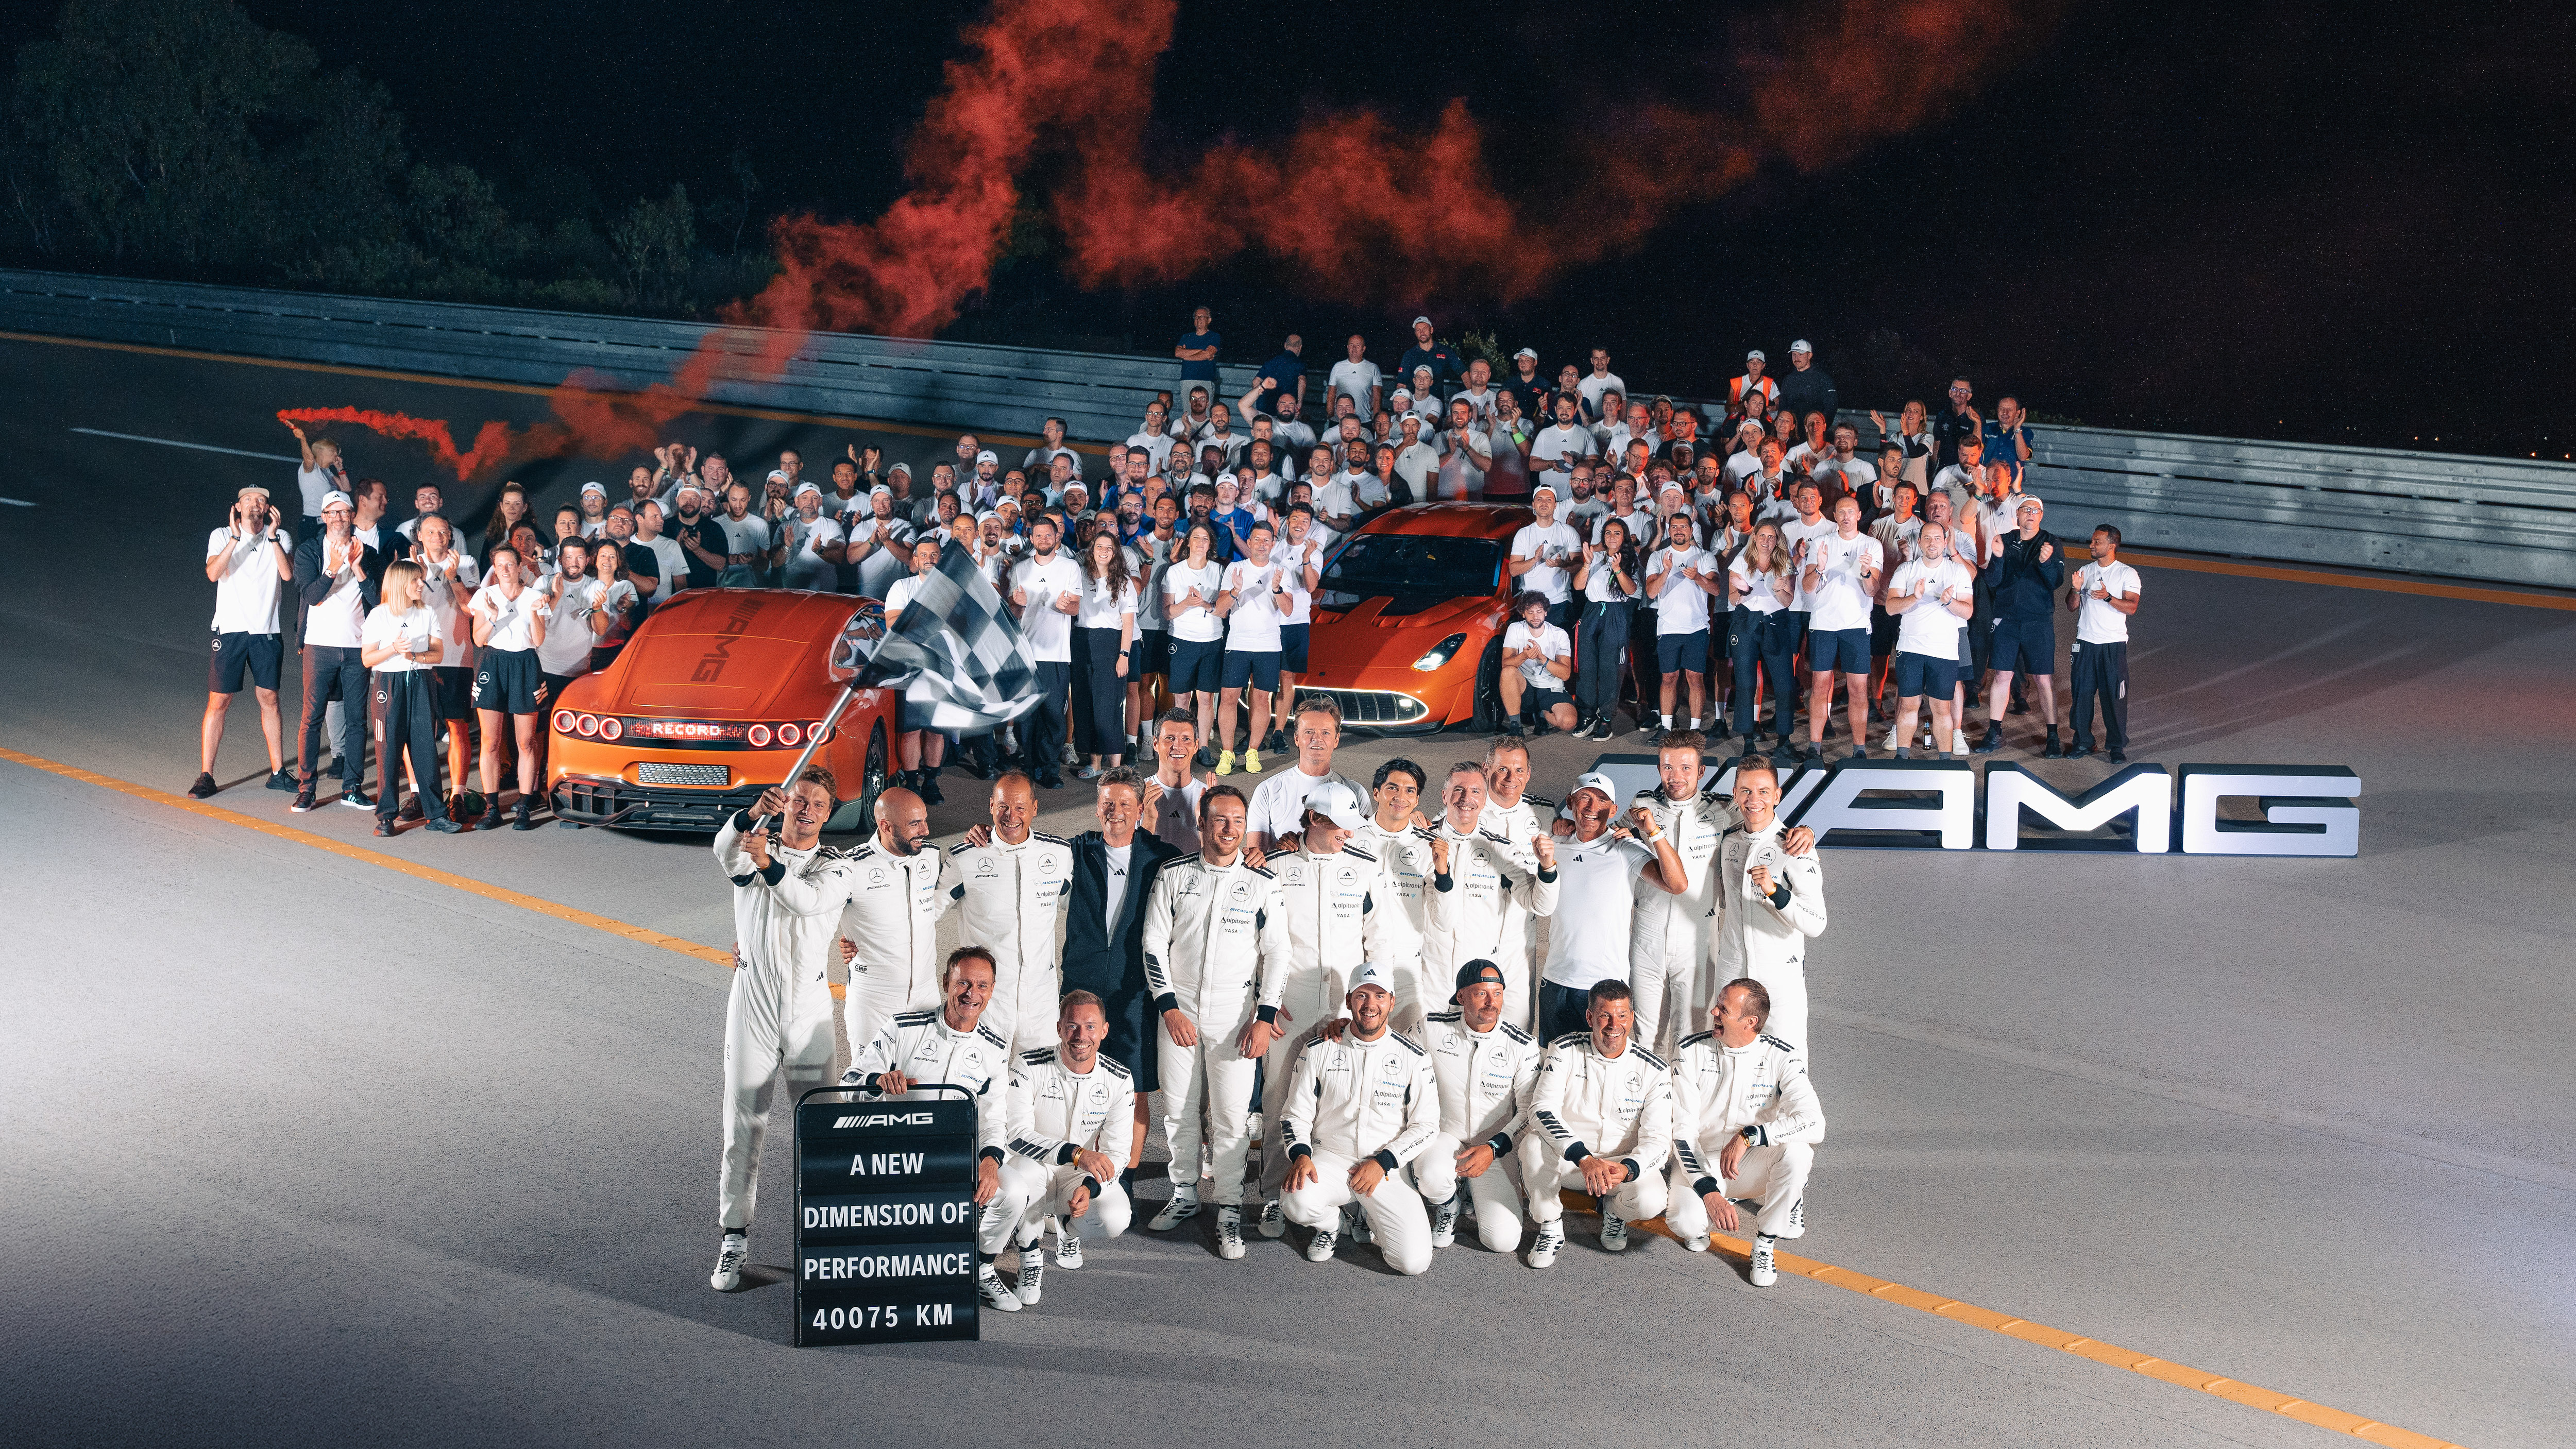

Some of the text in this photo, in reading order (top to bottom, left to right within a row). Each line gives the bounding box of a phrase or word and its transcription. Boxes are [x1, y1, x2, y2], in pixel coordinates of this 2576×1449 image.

[690, 616, 750, 682] AMG
[653, 723, 721, 736] RECORD
[1798, 760, 2361, 858] AMG
[1693, 842, 1718, 850] alpitronic
[961, 1073, 983, 1083] MICHELIN
[866, 1112, 933, 1127] AMG
[1774, 1130, 1795, 1139] AMG
[850, 1152, 924, 1176] A NEW
[804, 1202, 970, 1229] DIMENSION OF
[804, 1253, 970, 1280] PERFORMANCE
[812, 1303, 953, 1330] 40075 KM
